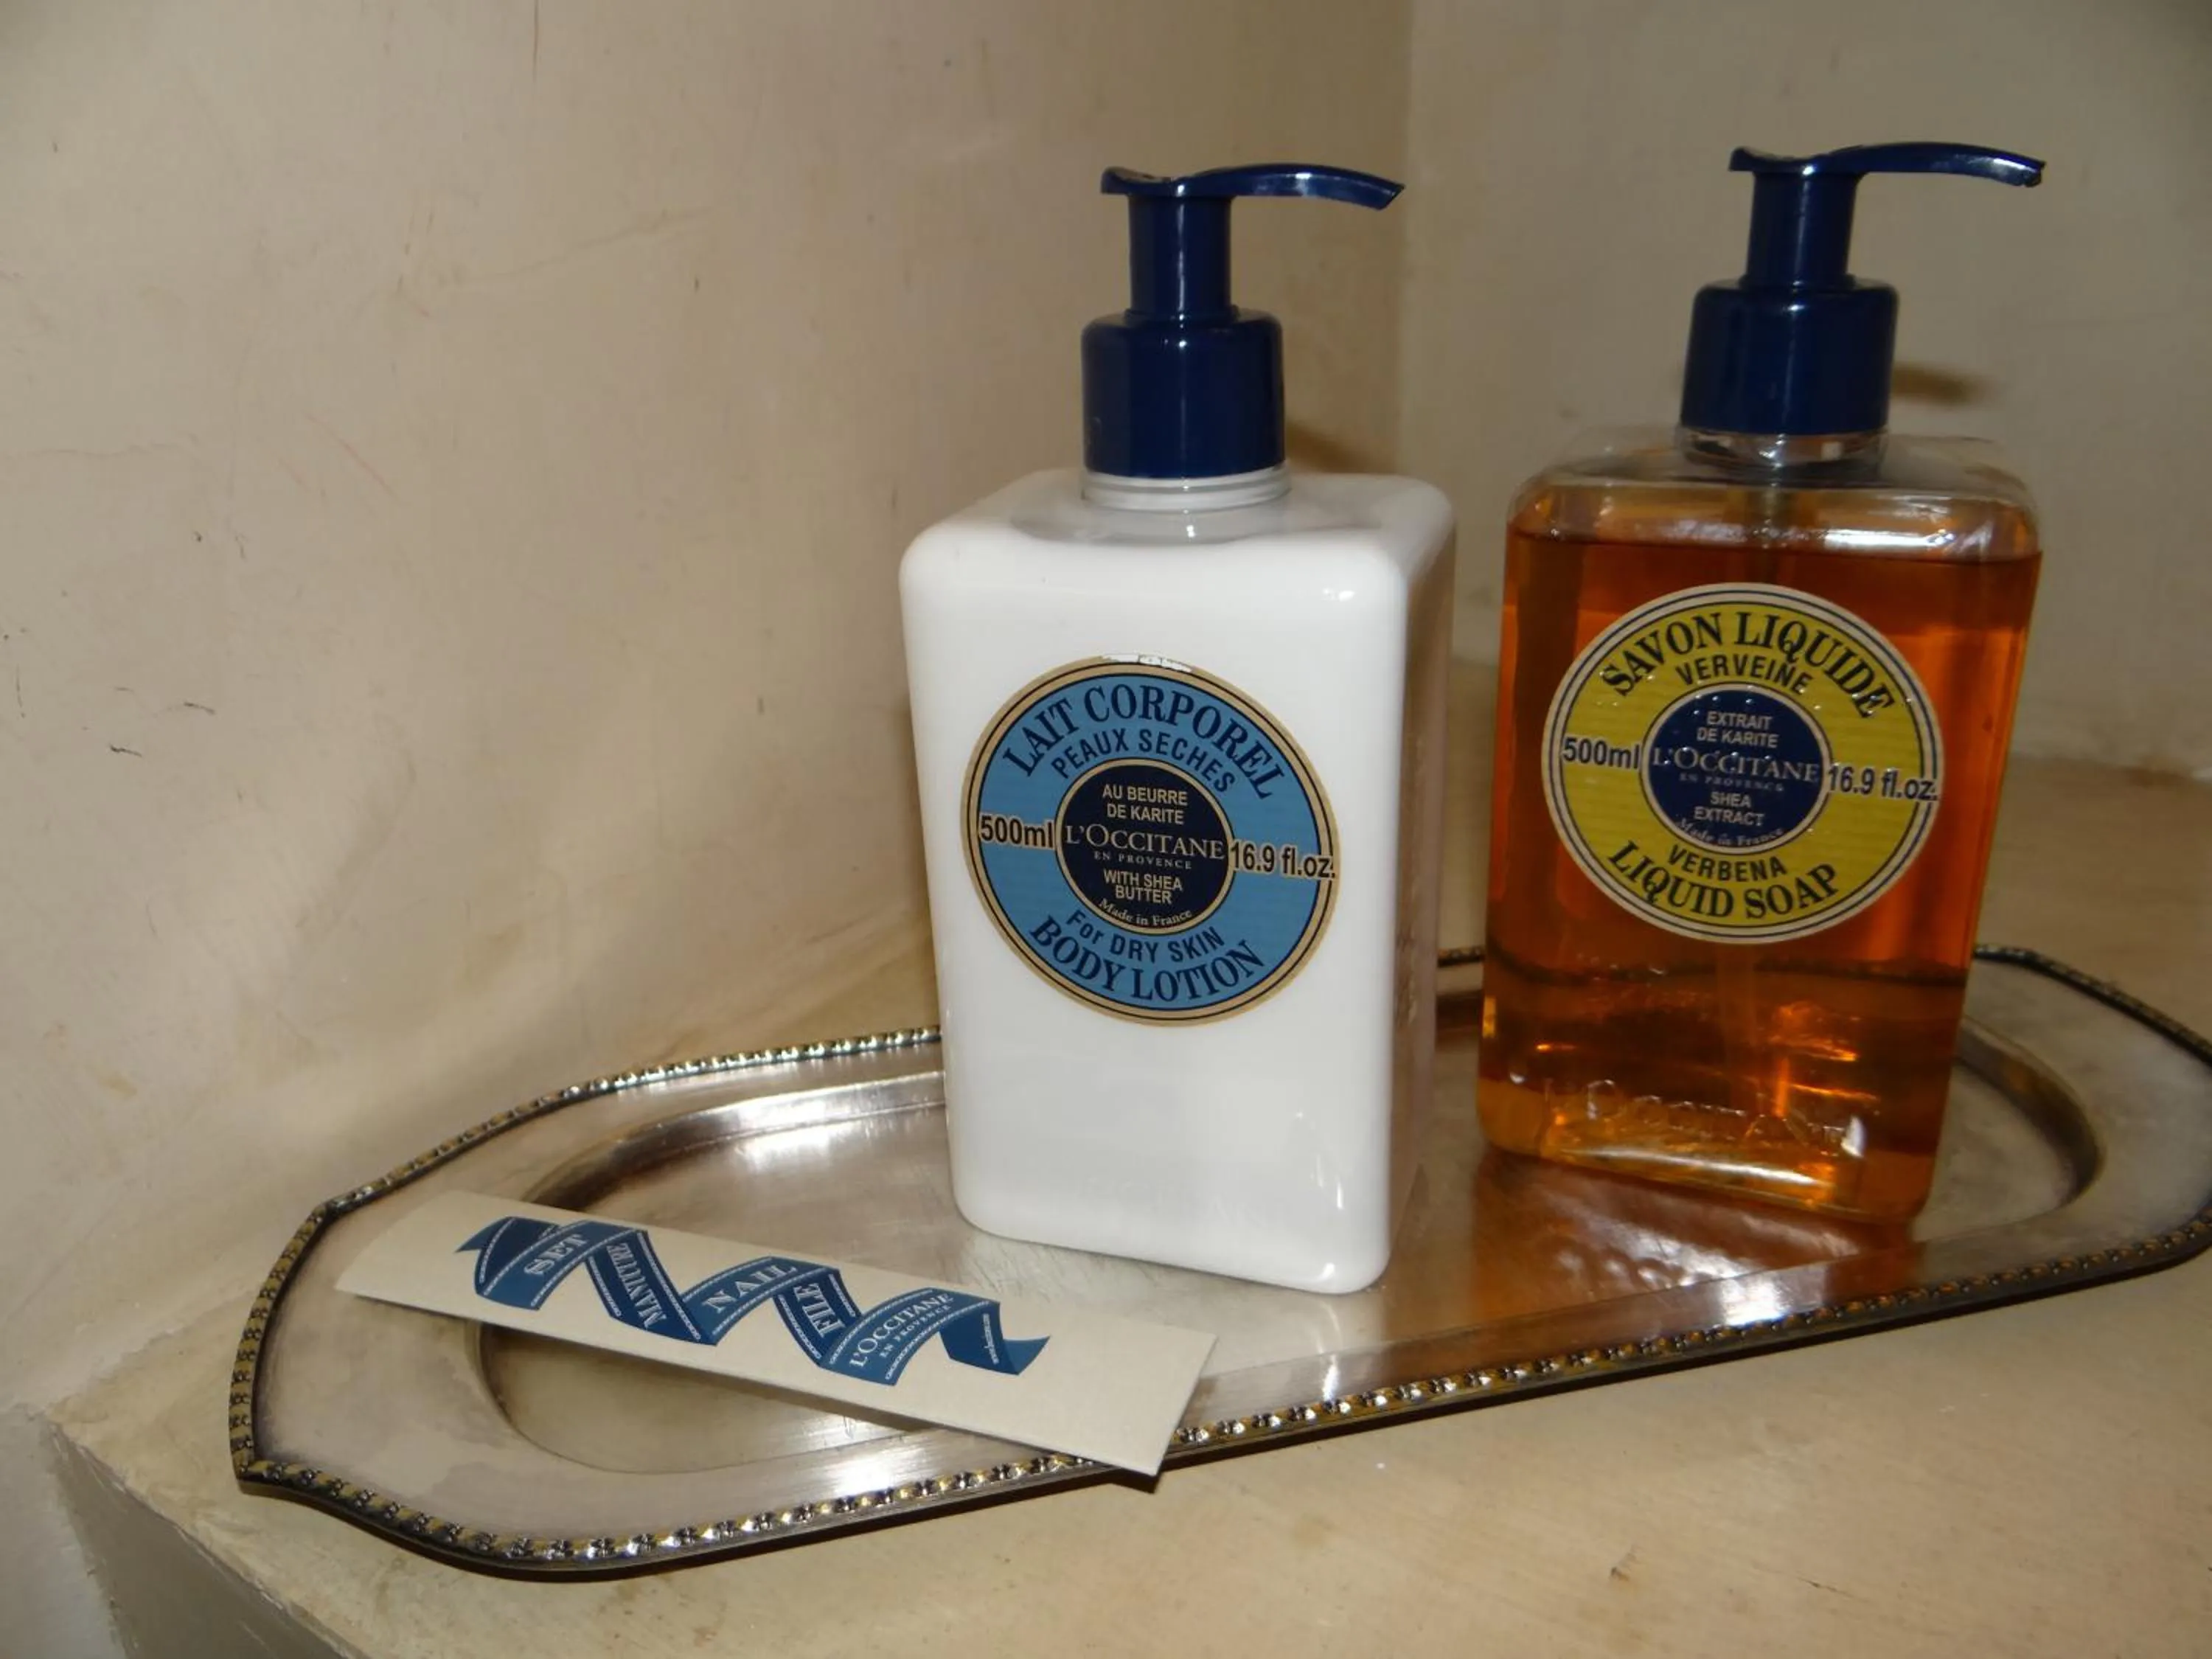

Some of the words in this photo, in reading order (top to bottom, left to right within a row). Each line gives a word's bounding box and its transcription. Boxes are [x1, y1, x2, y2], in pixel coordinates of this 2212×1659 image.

[1601, 612, 1722, 696] SAVON
[1735, 611, 1896, 719] LIQUIDE
[1676, 654, 1815, 696] VERVEINE
[1697, 727, 1718, 742] DE
[1721, 729, 1780, 748] KARITE
[1707, 711, 1773, 730] EXTRAIT
[1003, 698, 1079, 776] LAIT
[1084, 684, 1284, 799] CORPOREL
[1562, 737, 1641, 770] 500ml
[1050, 728, 1130, 779] PEAUX
[1138, 728, 1237, 793] SECHES
[1653, 746, 1820, 782] L'OCCITANE
[1102, 785, 1122, 799] AU
[1127, 787, 1188, 805] BEURRE
[1828, 763, 1874, 795] 16.9
[1107, 803, 1126, 818] DE
[1130, 805, 1184, 825] KARITE
[1694, 807, 1764, 827] EXTRACT
[1711, 791, 1751, 808] SHEA
[980, 815, 1054, 849] 500ml
[1065, 823, 1225, 859] L'OCCITANE
[1094, 851, 1110, 860] EN
[1119, 854, 1192, 869] PROVENCE
[1231, 842, 1275, 872] 16.9
[1667, 843, 1788, 883] VERBENA
[1104, 869, 1138, 885] WITH
[1144, 874, 1183, 891] SHEA
[1115, 885, 1172, 904] BUTTER
[1609, 841, 1734, 919] LIQUID
[1745, 863, 1842, 920] SOAP
[1099, 898, 1132, 922] Made
[1136, 914, 1149, 925] in
[1153, 910, 1192, 926] France
[1031, 916, 1126, 992] BODY
[1131, 939, 1266, 1002] LOTION
[1110, 934, 1158, 962] DRY
[1168, 926, 1225, 963] SKIN
[524, 1233, 588, 1275] SET
[702, 1265, 798, 1314] NAIL
[793, 1282, 846, 1338] FILE
[849, 1293, 955, 1368] L'OCCITANE
[894, 1305, 951, 1341] PROVENCE
